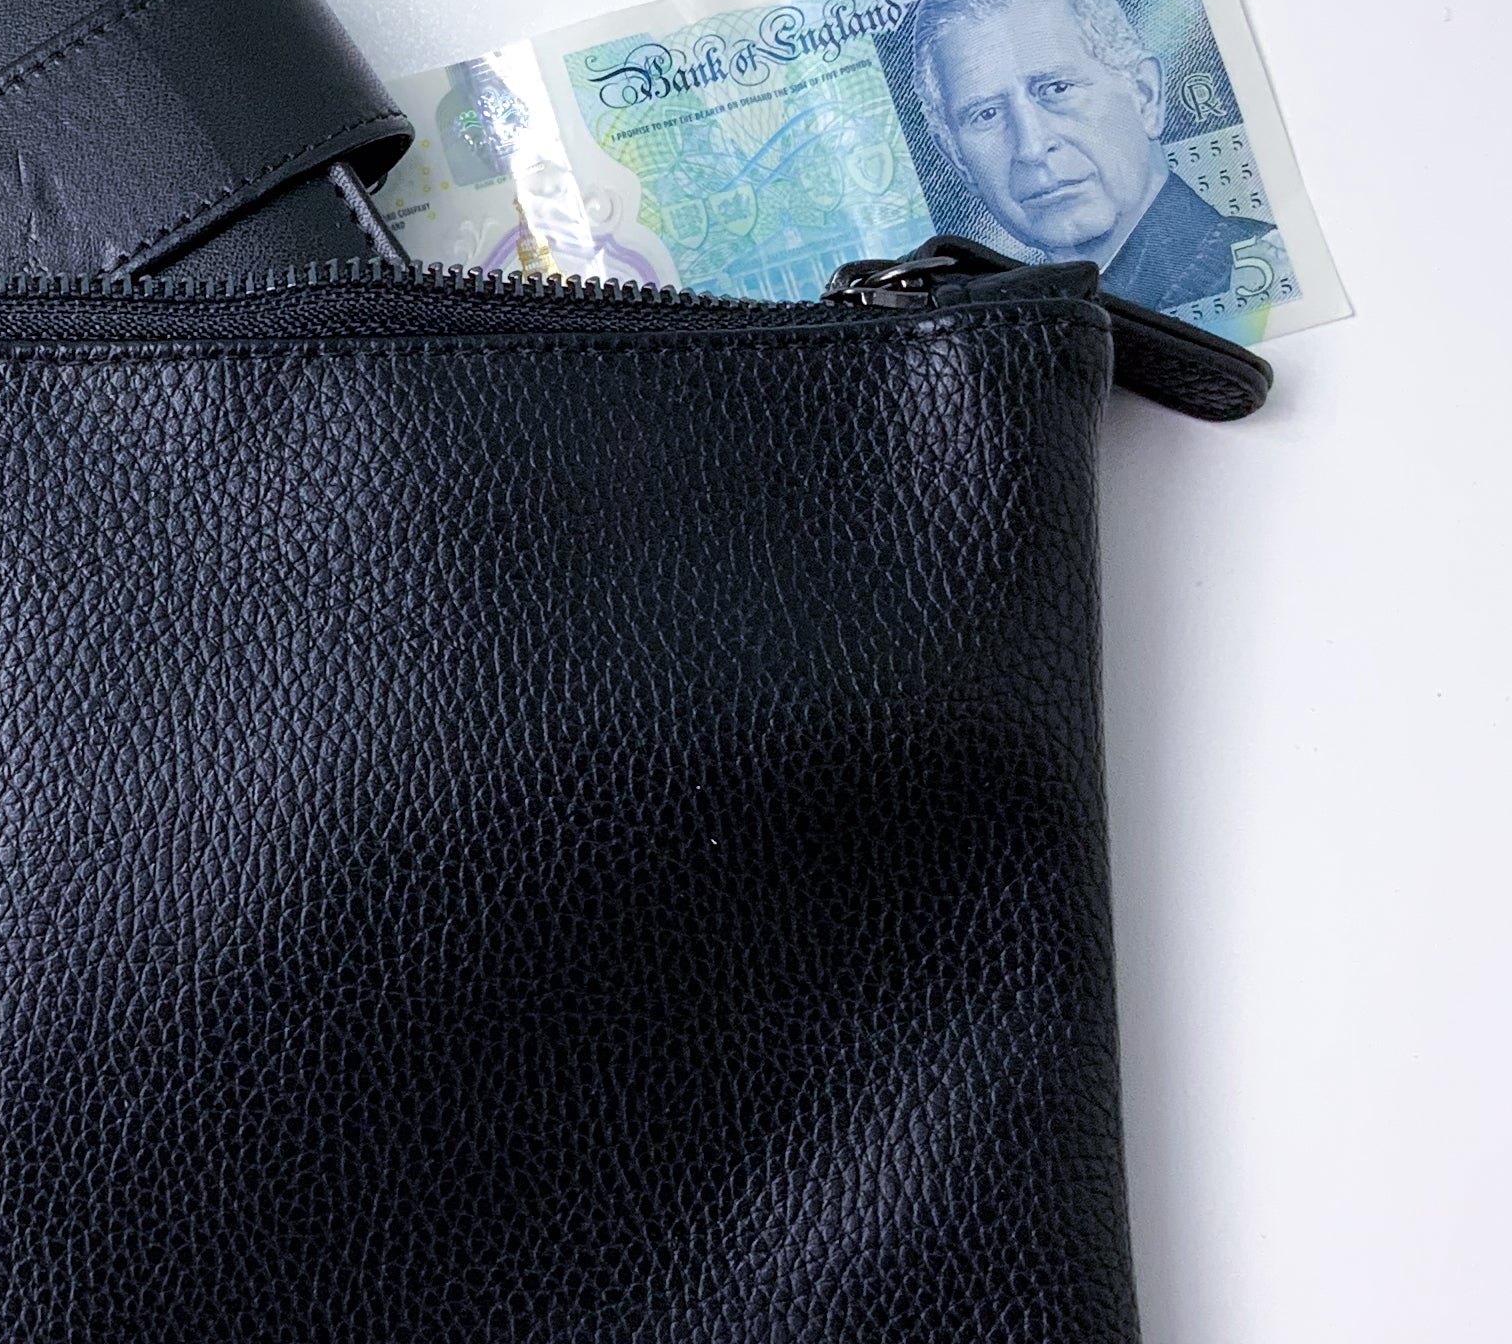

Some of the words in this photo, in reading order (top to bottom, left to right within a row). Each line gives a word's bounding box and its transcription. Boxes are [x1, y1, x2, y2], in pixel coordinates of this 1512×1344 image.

[585, 34, 728, 109] Bank
[651, 122, 662, 132] TO
[663, 117, 678, 128] PAY
[1230, 235, 1274, 297] 5
